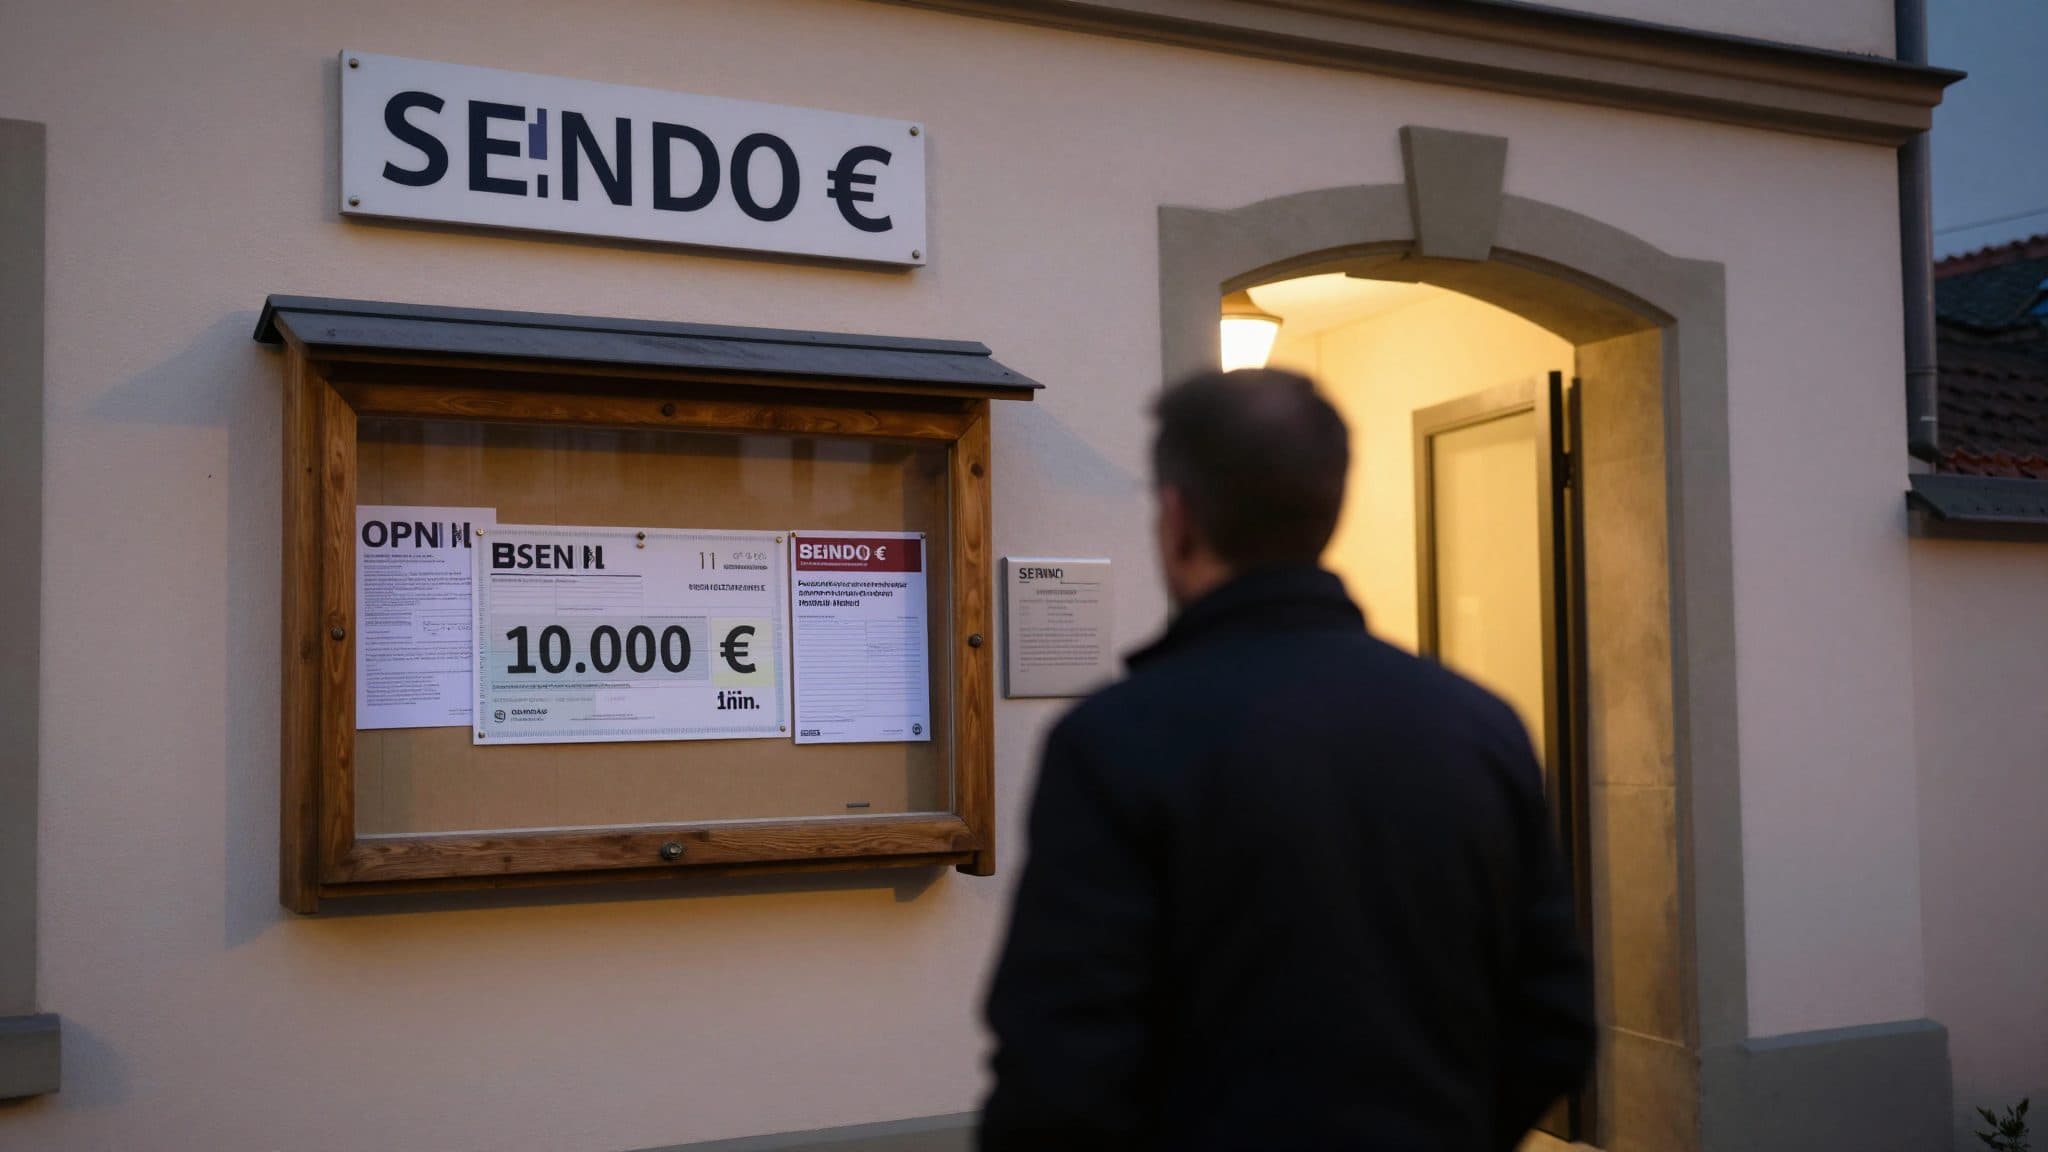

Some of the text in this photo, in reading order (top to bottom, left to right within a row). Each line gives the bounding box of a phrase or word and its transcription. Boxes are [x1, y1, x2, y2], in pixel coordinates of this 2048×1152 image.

[826, 145, 894, 233] €
[506, 625, 756, 674] 10.000 €
